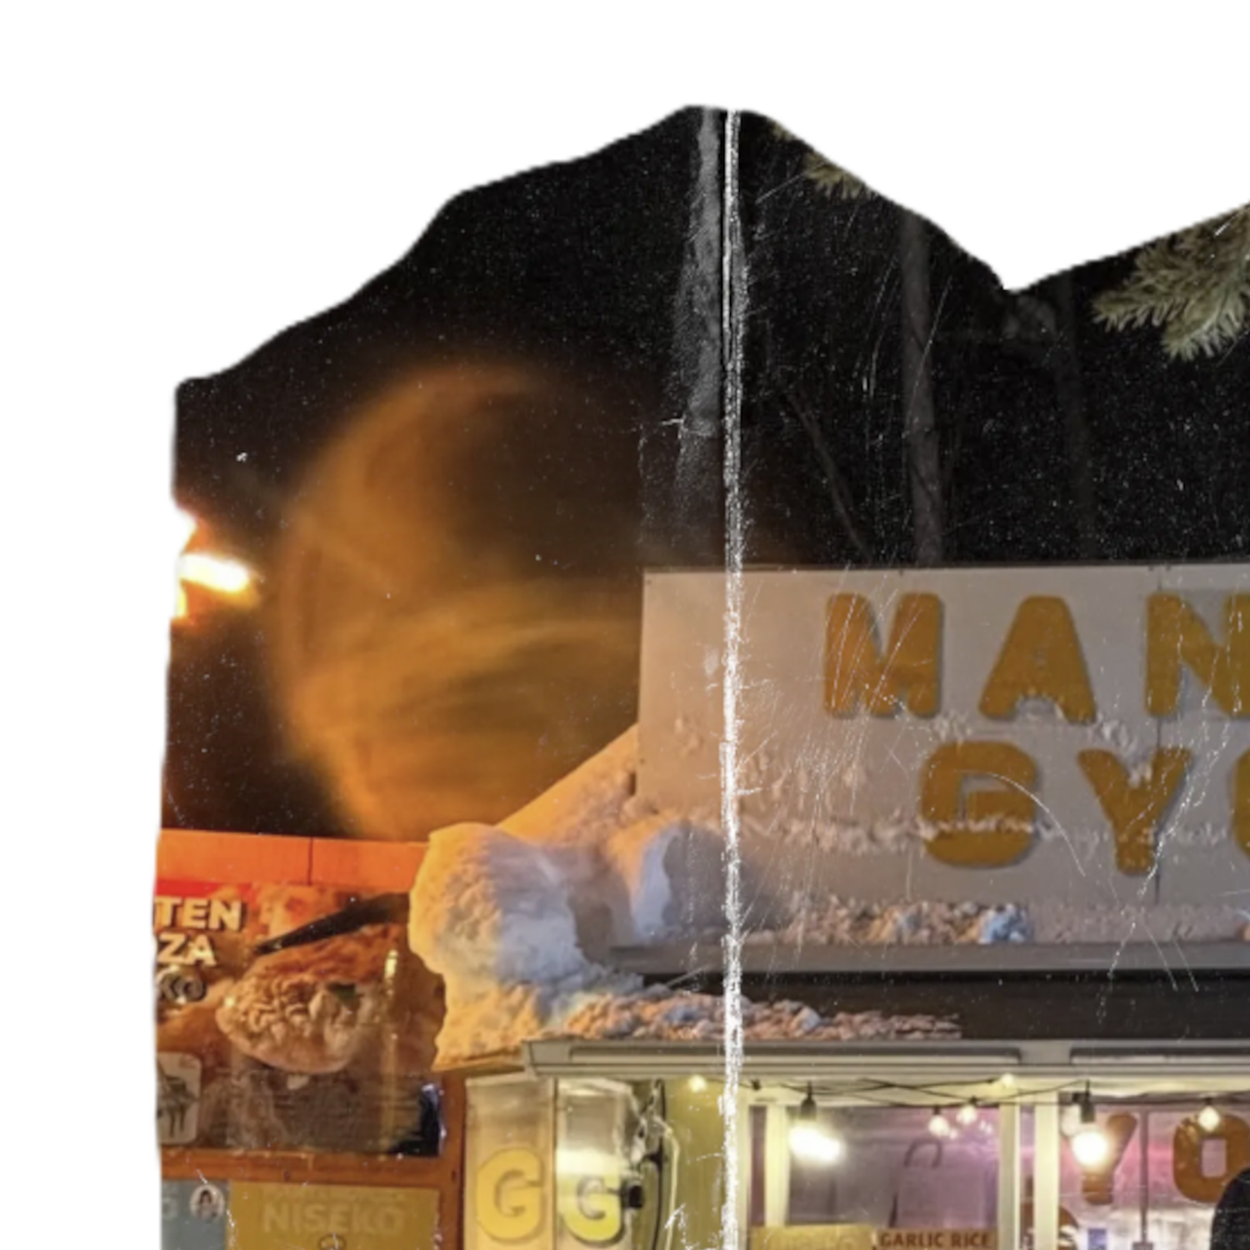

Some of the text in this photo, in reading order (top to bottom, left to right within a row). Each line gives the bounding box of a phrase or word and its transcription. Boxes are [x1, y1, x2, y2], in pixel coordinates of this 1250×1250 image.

[263, 1203, 405, 1234] NISEKO
[880, 1232, 943, 1248] GARLIC
[951, 1232, 990, 1248] RICE
